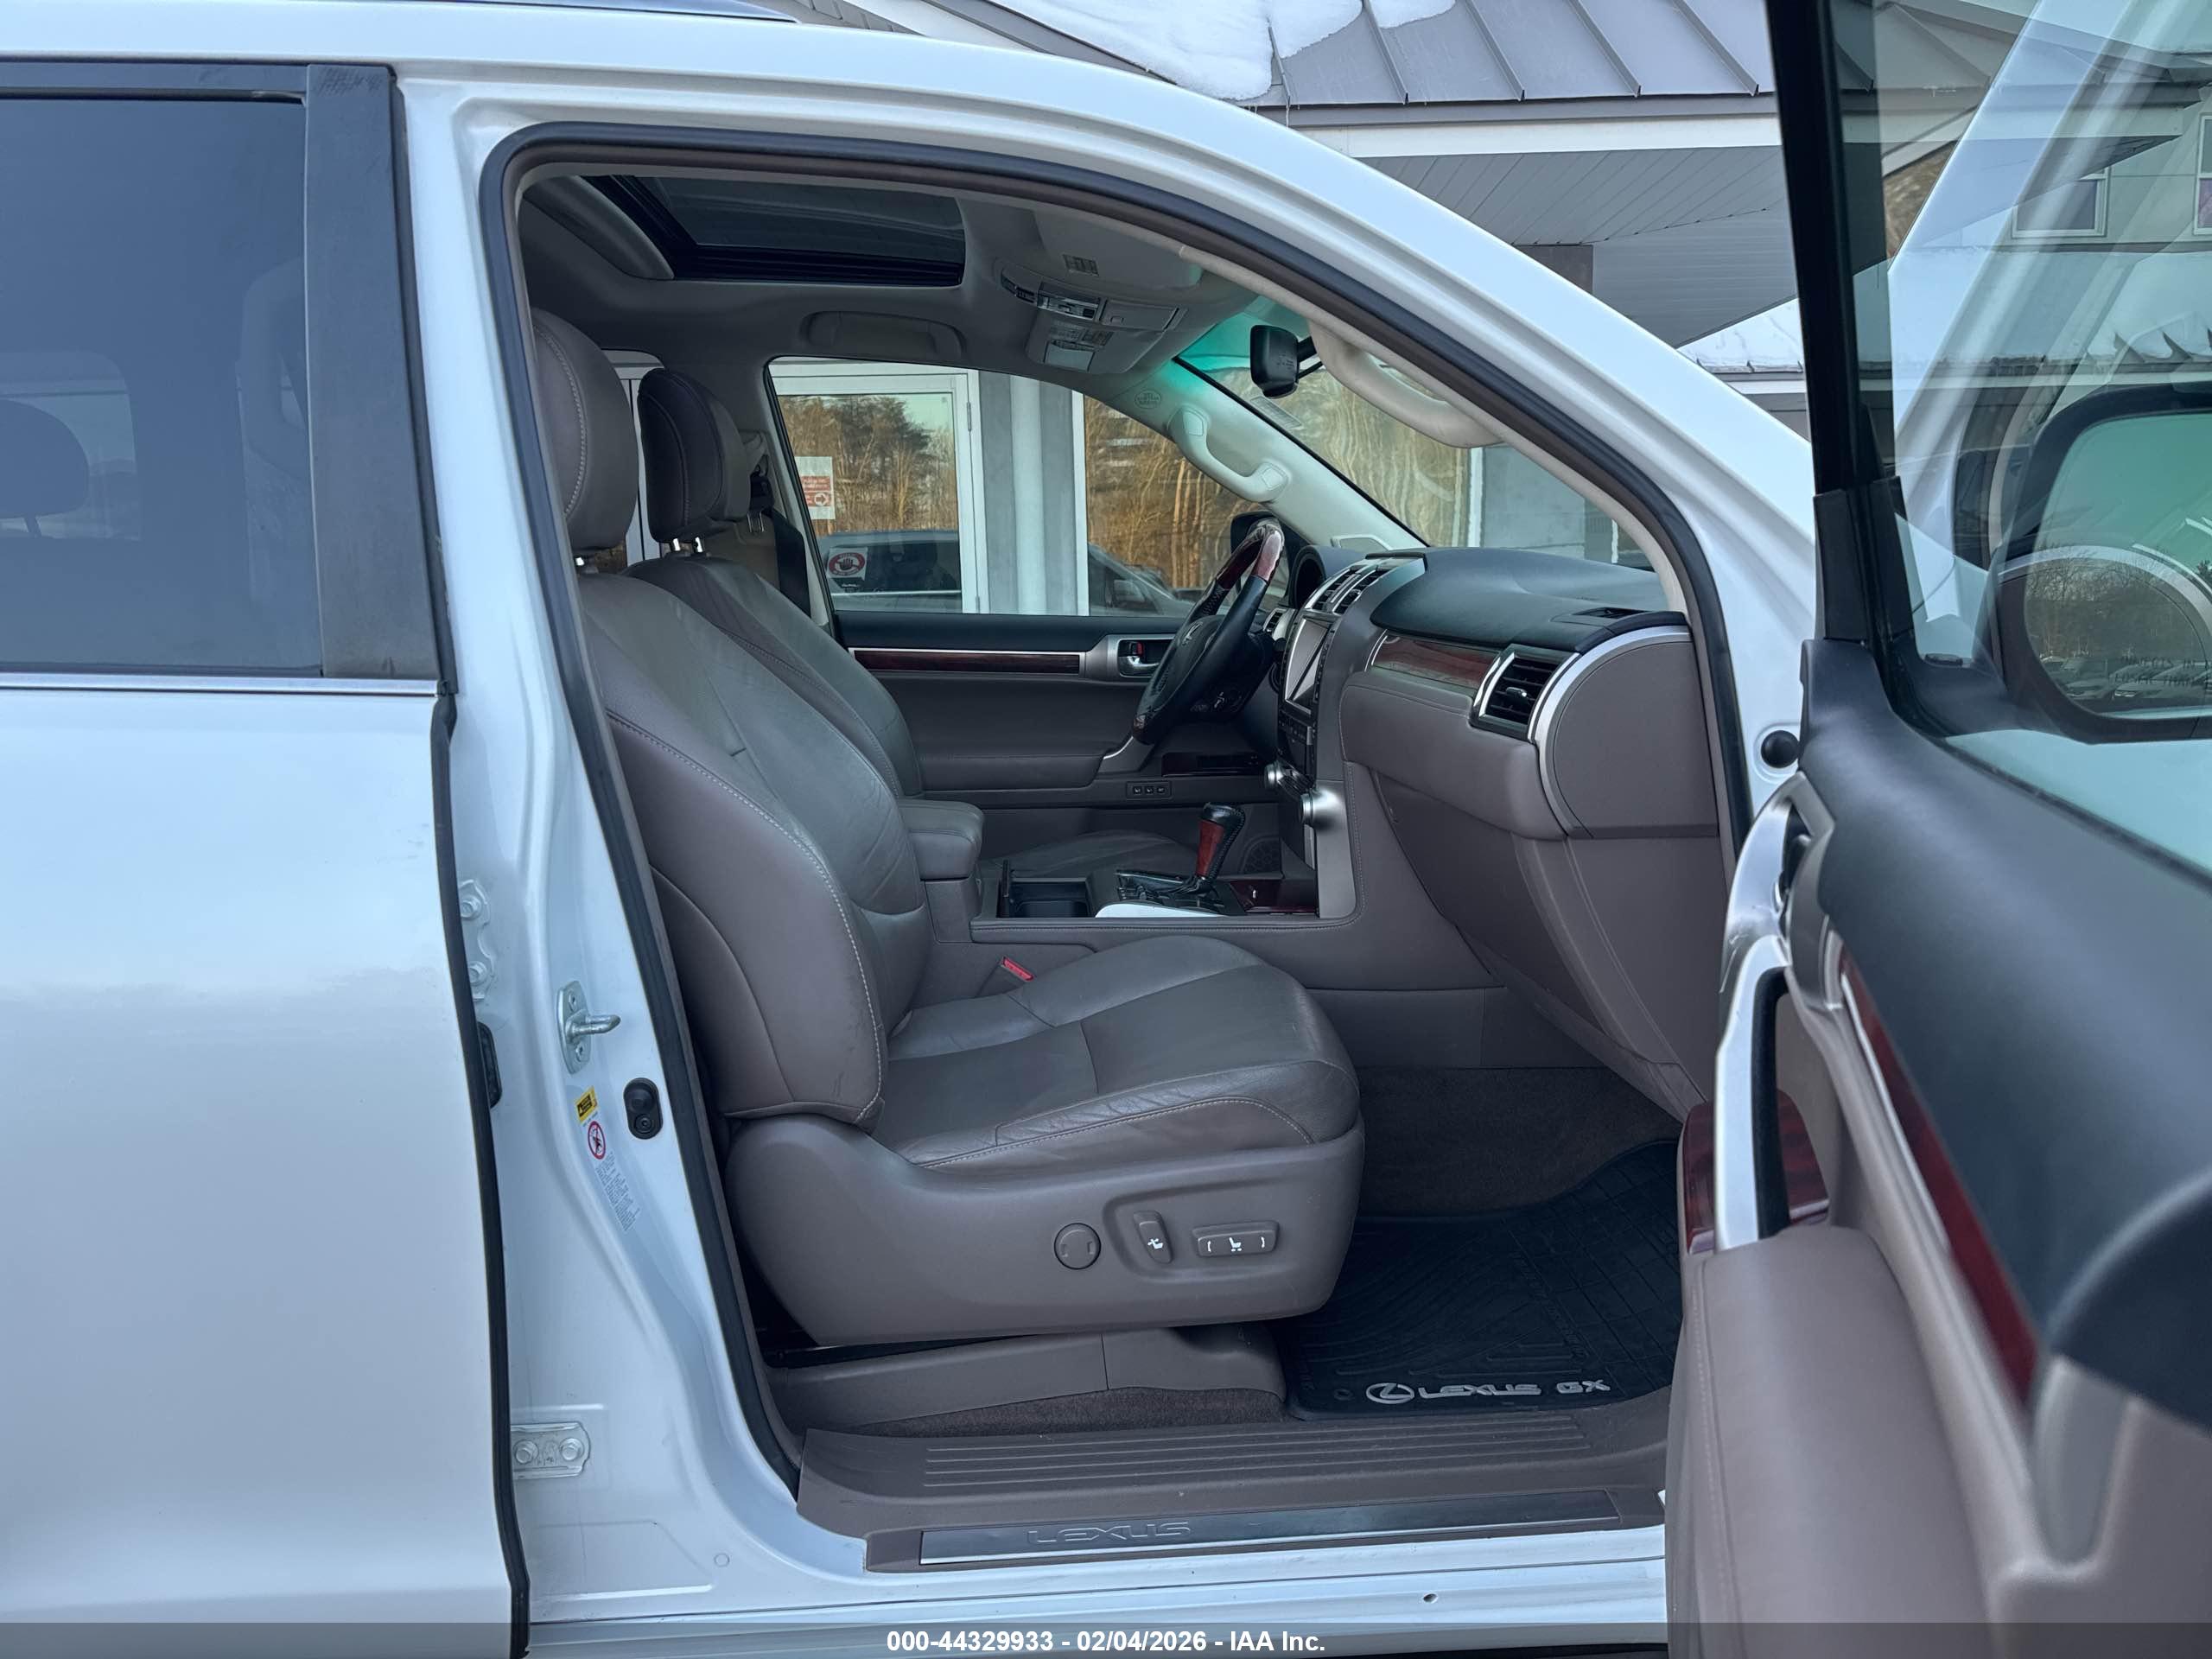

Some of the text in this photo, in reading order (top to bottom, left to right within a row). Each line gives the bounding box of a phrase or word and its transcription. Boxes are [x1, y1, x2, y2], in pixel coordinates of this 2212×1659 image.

[1418, 1379, 1611, 1399] LEXUS GX
[1027, 1521, 1192, 1544] LEXUS
